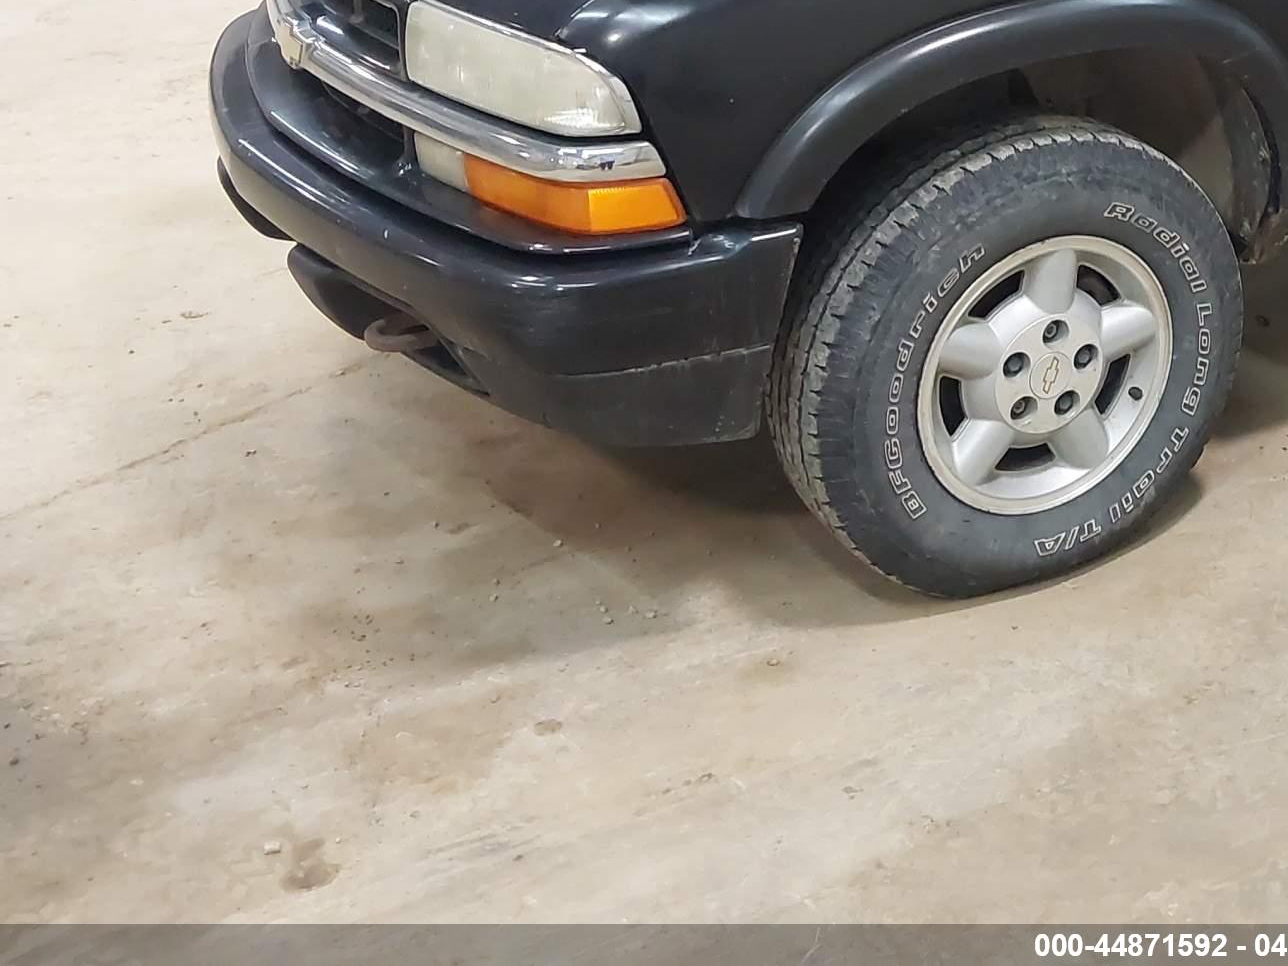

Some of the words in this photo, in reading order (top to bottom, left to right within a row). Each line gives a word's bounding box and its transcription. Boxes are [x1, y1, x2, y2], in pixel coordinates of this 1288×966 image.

[1103, 201, 1208, 293] Radial
[884, 243, 986, 520] BFGoodrich
[1181, 302, 1214, 418] Long
[1109, 425, 1191, 525] Trail
[1033, 518, 1103, 557] T/A
